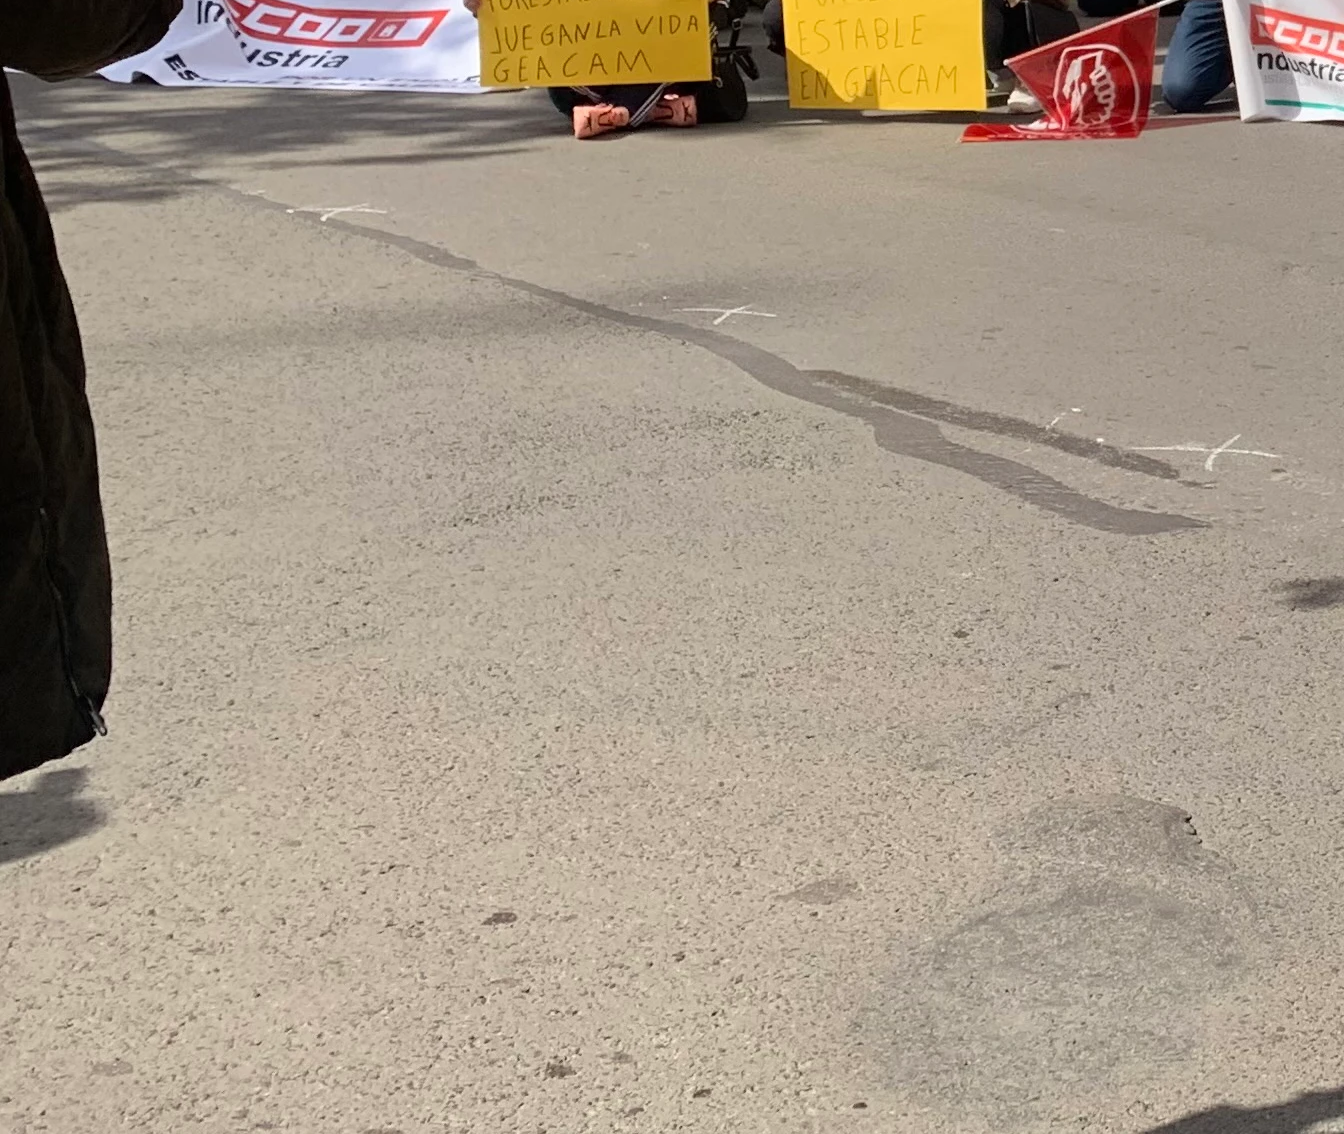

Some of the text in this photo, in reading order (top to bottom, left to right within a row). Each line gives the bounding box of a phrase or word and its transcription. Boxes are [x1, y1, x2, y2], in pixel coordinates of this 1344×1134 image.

[635, 14, 699, 36] VIDA
[797, 14, 927, 56] ESTABLE
[493, 49, 653, 83] GEACAM
[800, 63, 959, 101] EN GEACAM
